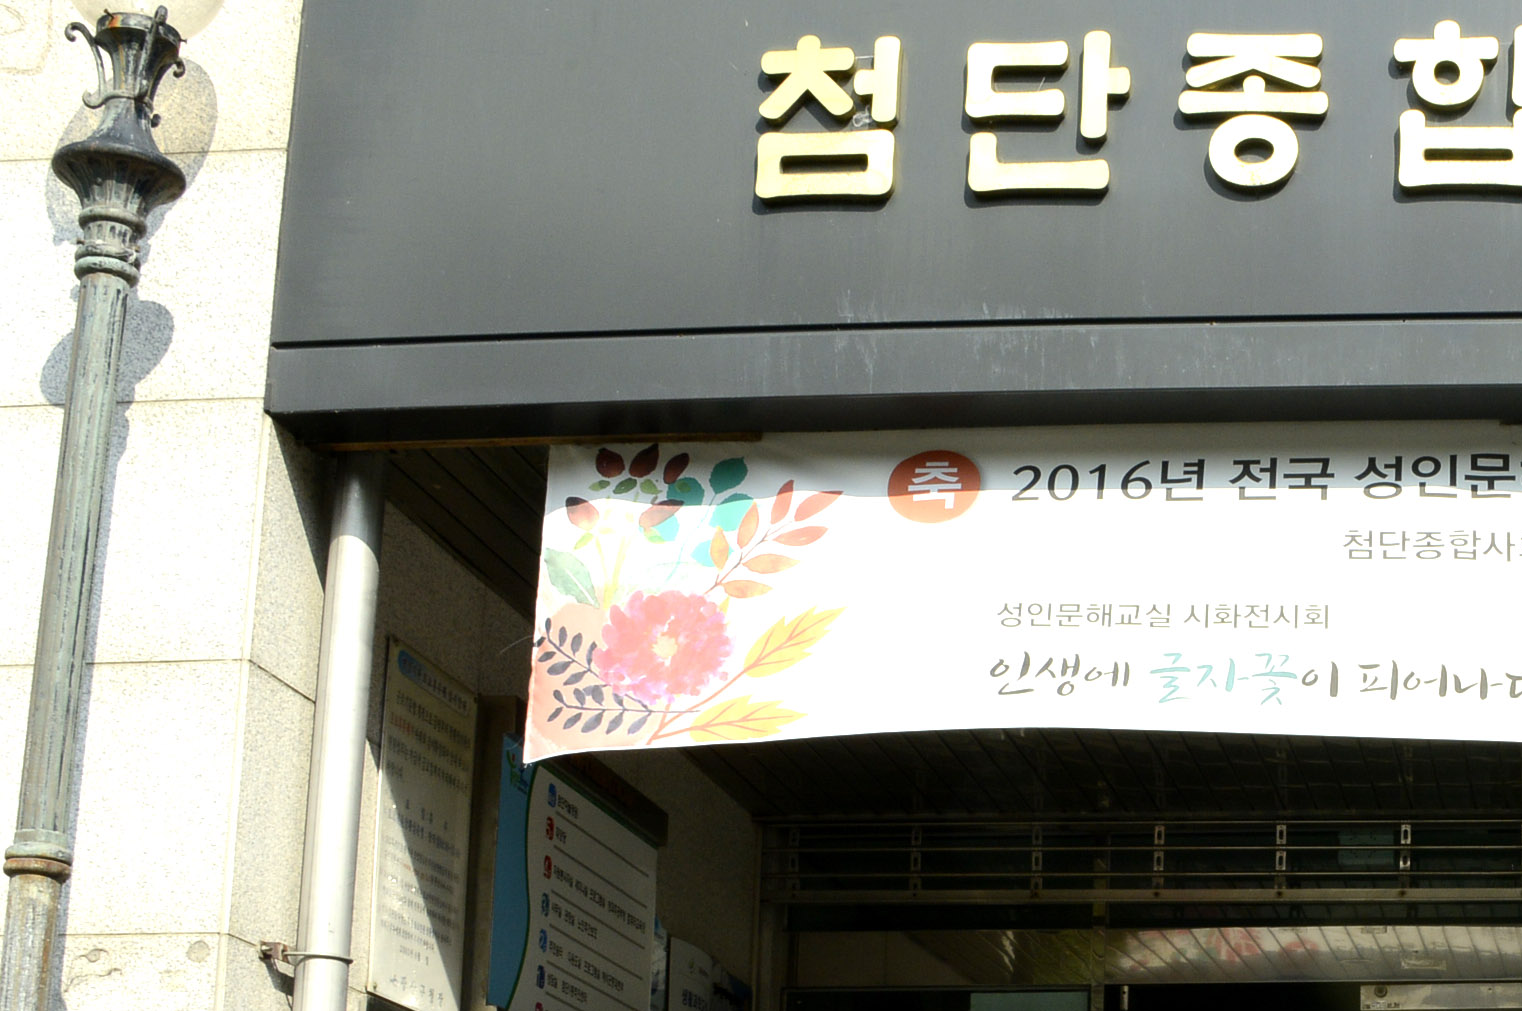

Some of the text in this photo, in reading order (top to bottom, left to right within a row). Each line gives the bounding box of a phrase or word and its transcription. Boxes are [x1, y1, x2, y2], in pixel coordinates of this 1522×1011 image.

[907, 461, 963, 509] 축
[1011, 458, 1206, 501] 2016년
[1228, 457, 1336, 501] 전국
[997, 602, 1330, 630] 성인문해교실 시화전시회
[988, 650, 1132, 697] 인생에
